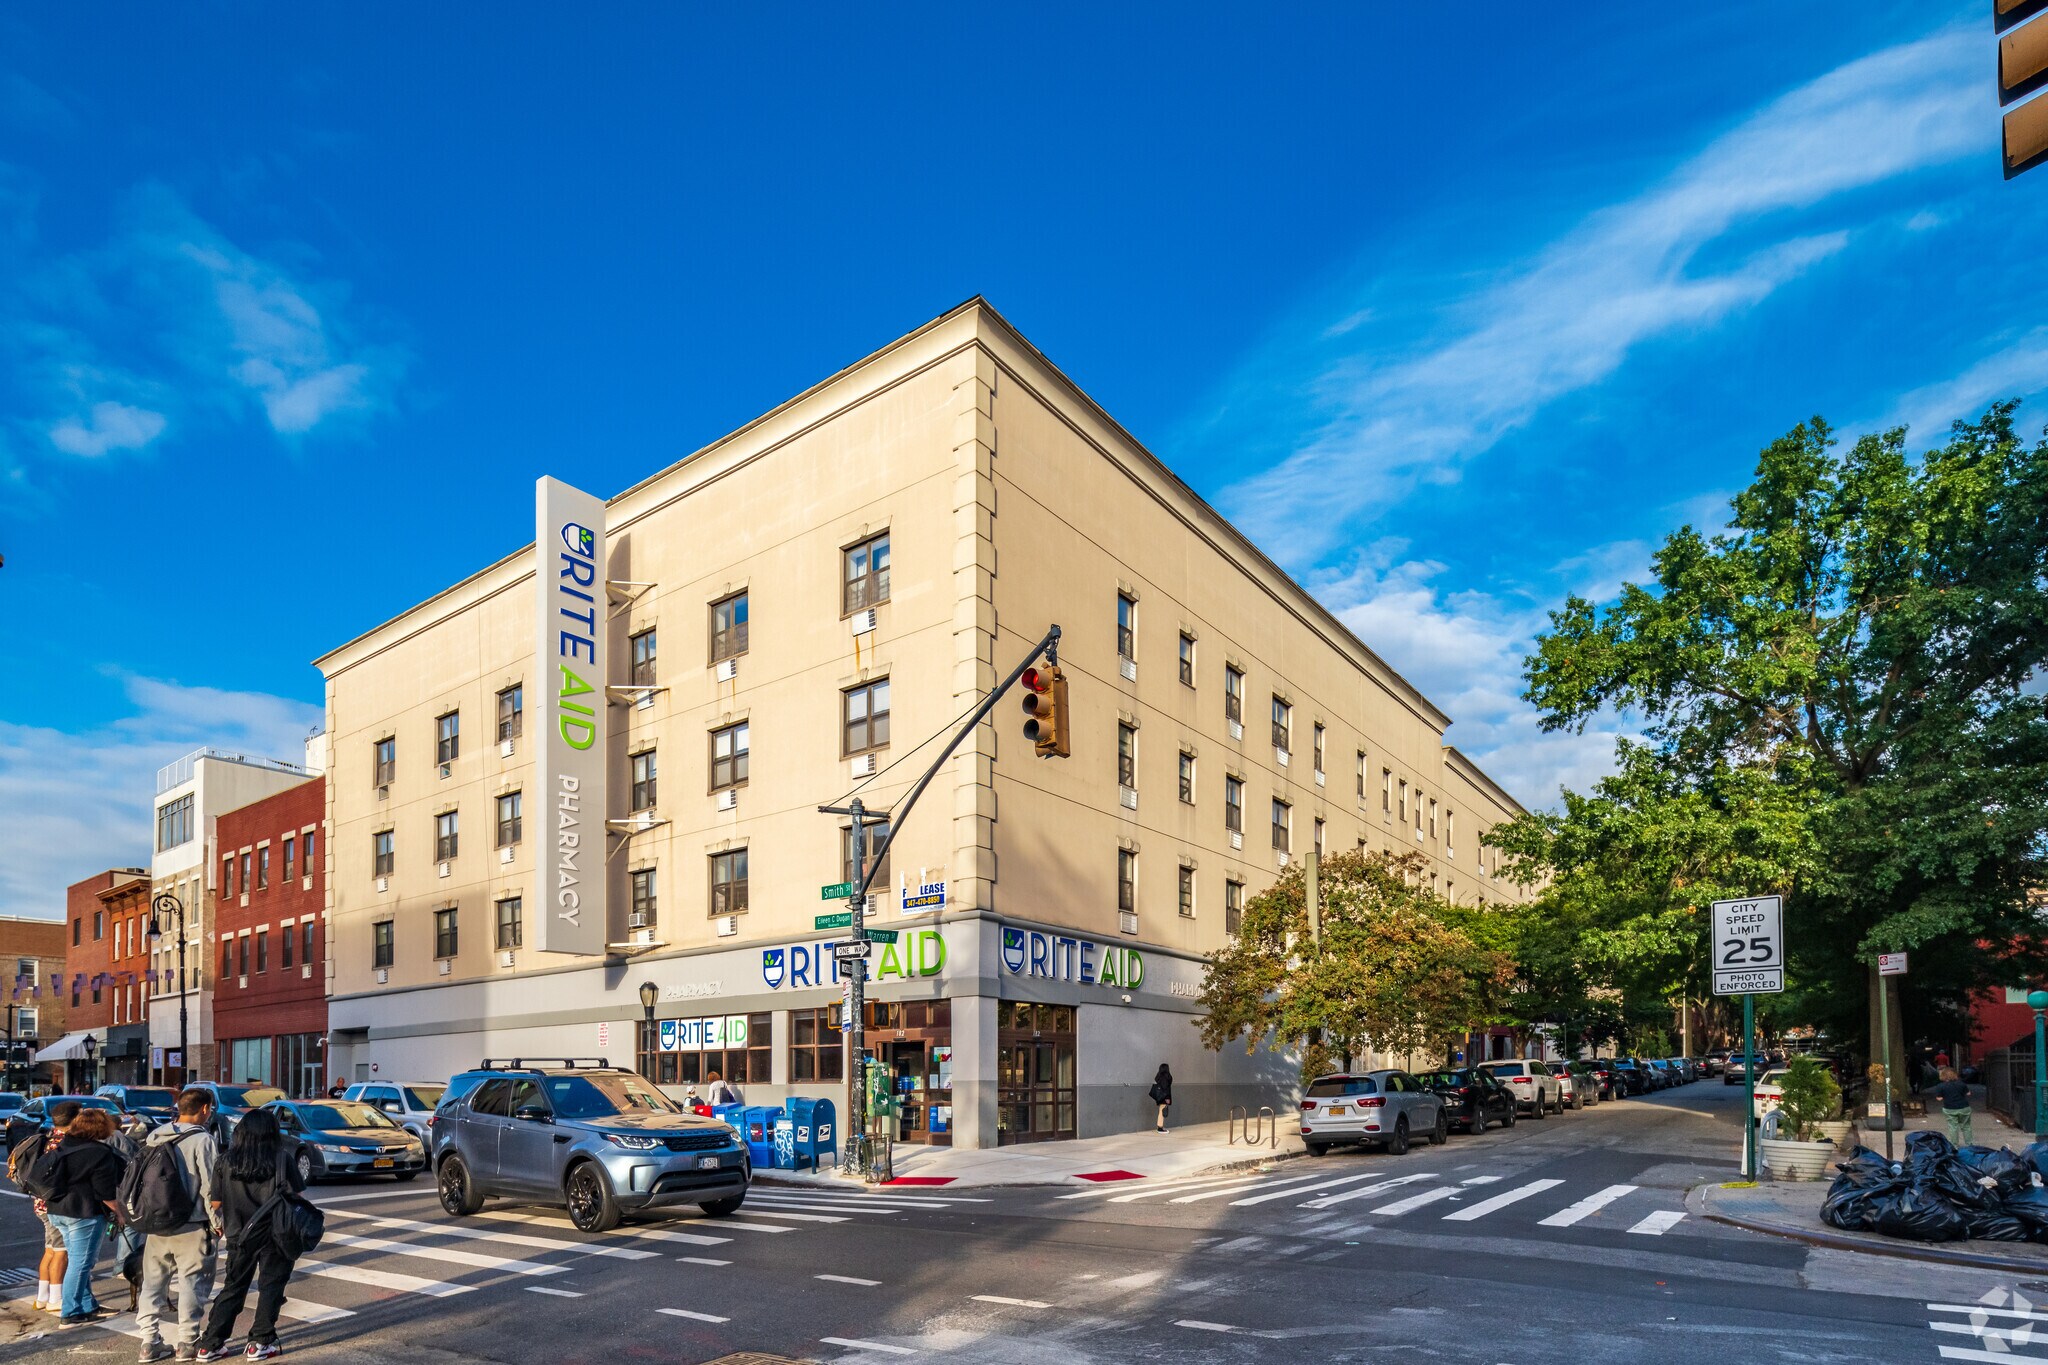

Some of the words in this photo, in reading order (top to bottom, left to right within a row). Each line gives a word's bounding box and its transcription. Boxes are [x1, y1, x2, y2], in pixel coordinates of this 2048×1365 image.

[559, 552, 596, 665] RITE
[559, 663, 596, 750] AID
[559, 774, 580, 927] PHARMACY
[824, 885, 844, 899] Smith
[920, 882, 945, 896] LEASE
[1731, 903, 1759, 913] CITY
[817, 916, 831, 925] Eileen
[831, 915, 835, 923] C
[836, 914, 850, 924] Dugan
[1726, 913, 1765, 925] SPEED
[868, 931, 890, 942] Warren
[1730, 925, 1762, 935] LIMIT
[839, 947, 850, 955] ONE
[854, 945, 866, 953] WAY
[1722, 936, 1773, 964] 25
[791, 940, 868, 987] RIT
[877, 930, 947, 981] AID
[1028, 931, 1095, 984] RITE
[1098, 945, 1144, 989] AID
[1730, 973, 1765, 982] PHOTO
[1720, 980, 1776, 990] ENFORCED
[677, 1021, 714, 1044] RITE
[717, 1020, 747, 1042] AID
